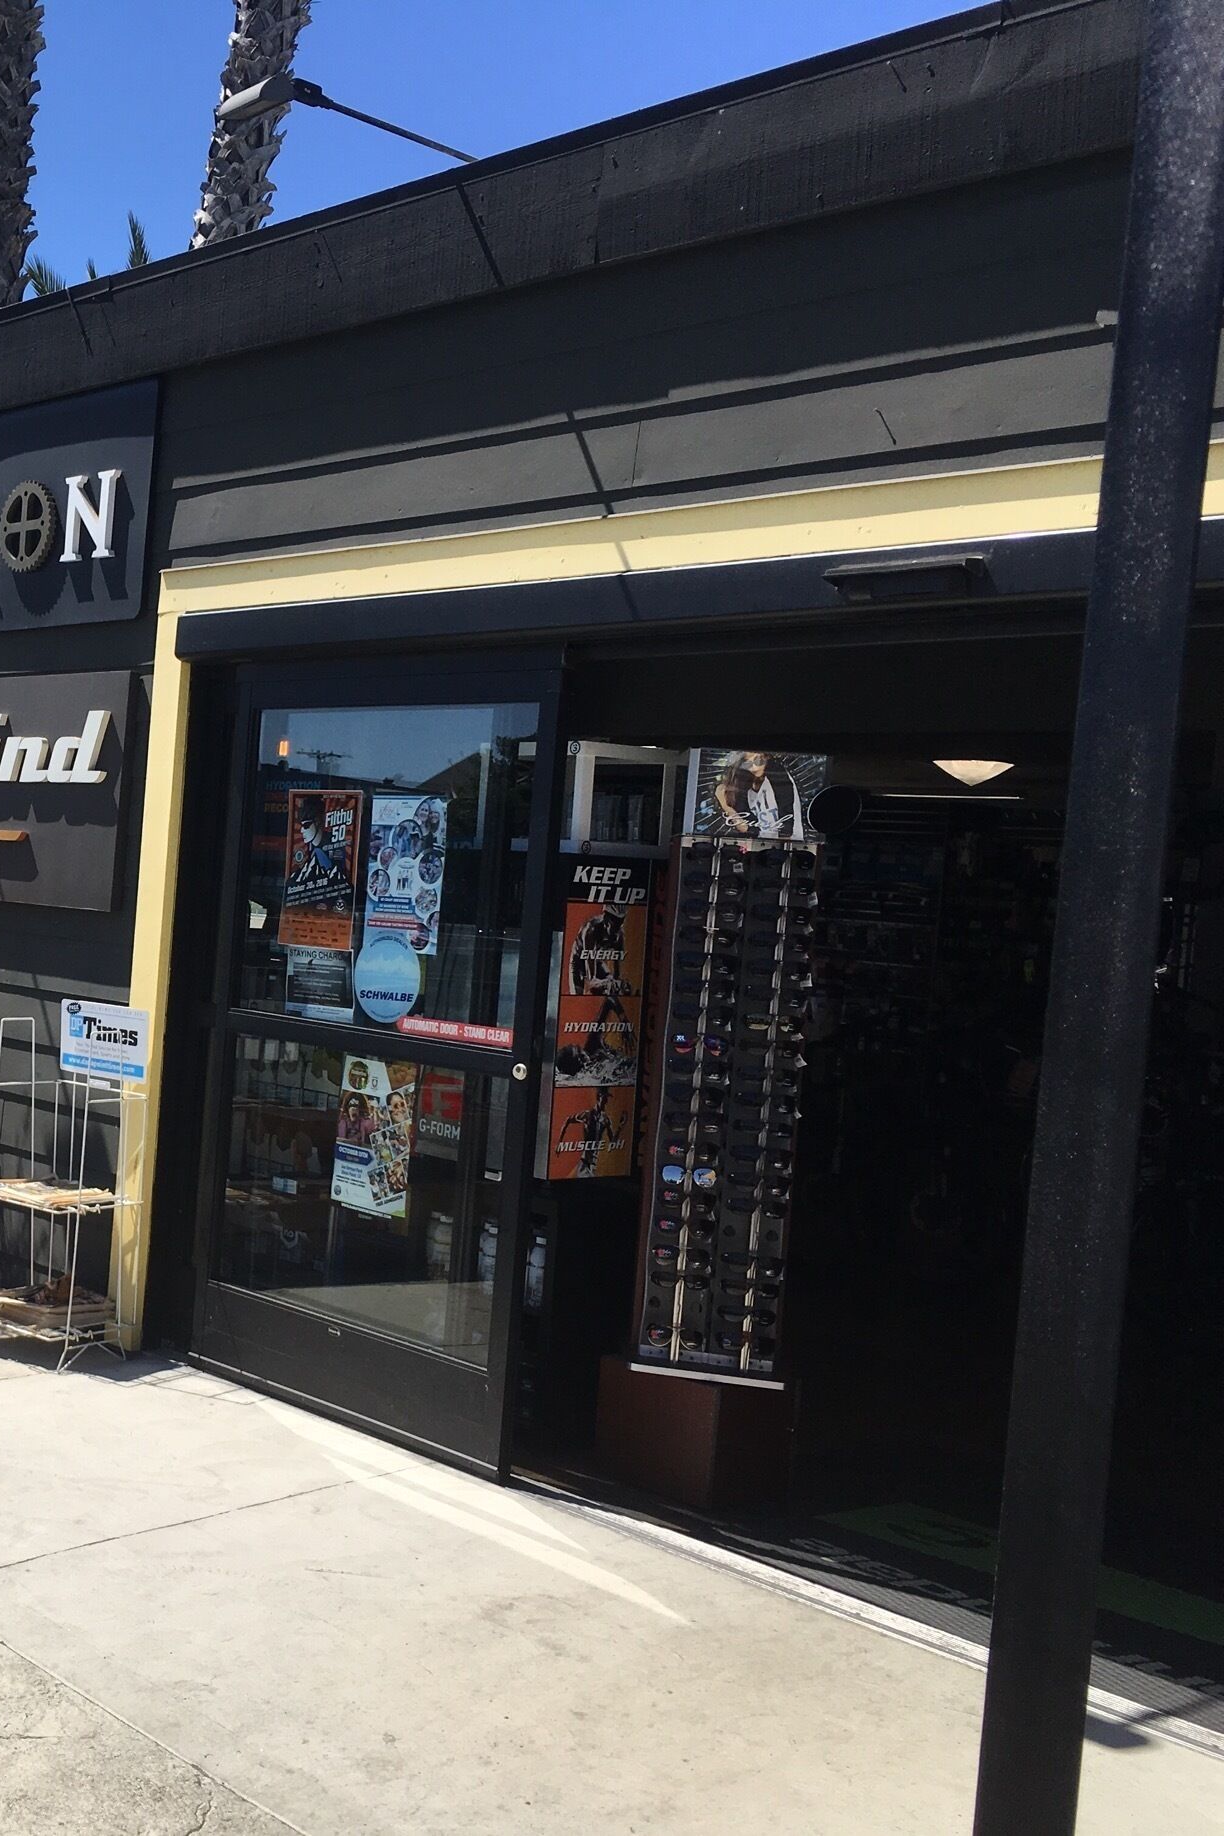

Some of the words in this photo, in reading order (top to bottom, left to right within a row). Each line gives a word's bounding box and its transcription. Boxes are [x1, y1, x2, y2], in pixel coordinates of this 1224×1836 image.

[325, 808, 353, 827] Filthy
[331, 824, 346, 843] 50
[573, 865, 632, 885] KEEP
[588, 885, 611, 903] IT
[614, 887, 646, 904] UP
[289, 949, 317, 959] STAYING
[579, 949, 628, 961] ENERGY
[359, 989, 415, 1003] SCHWALBE
[83, 1016, 138, 1047] Times
[402, 1020, 439, 1034] AUTOMATIC
[439, 1022, 458, 1036] DOOR
[463, 1025, 486, 1040] STAND
[487, 1028, 510, 1043] CLEAR
[564, 1021, 634, 1034] HYDRATION
[419, 1118, 462, 1141] G-FORM
[557, 1139, 606, 1153] MUSCLE
[609, 1139, 625, 1153] pH
